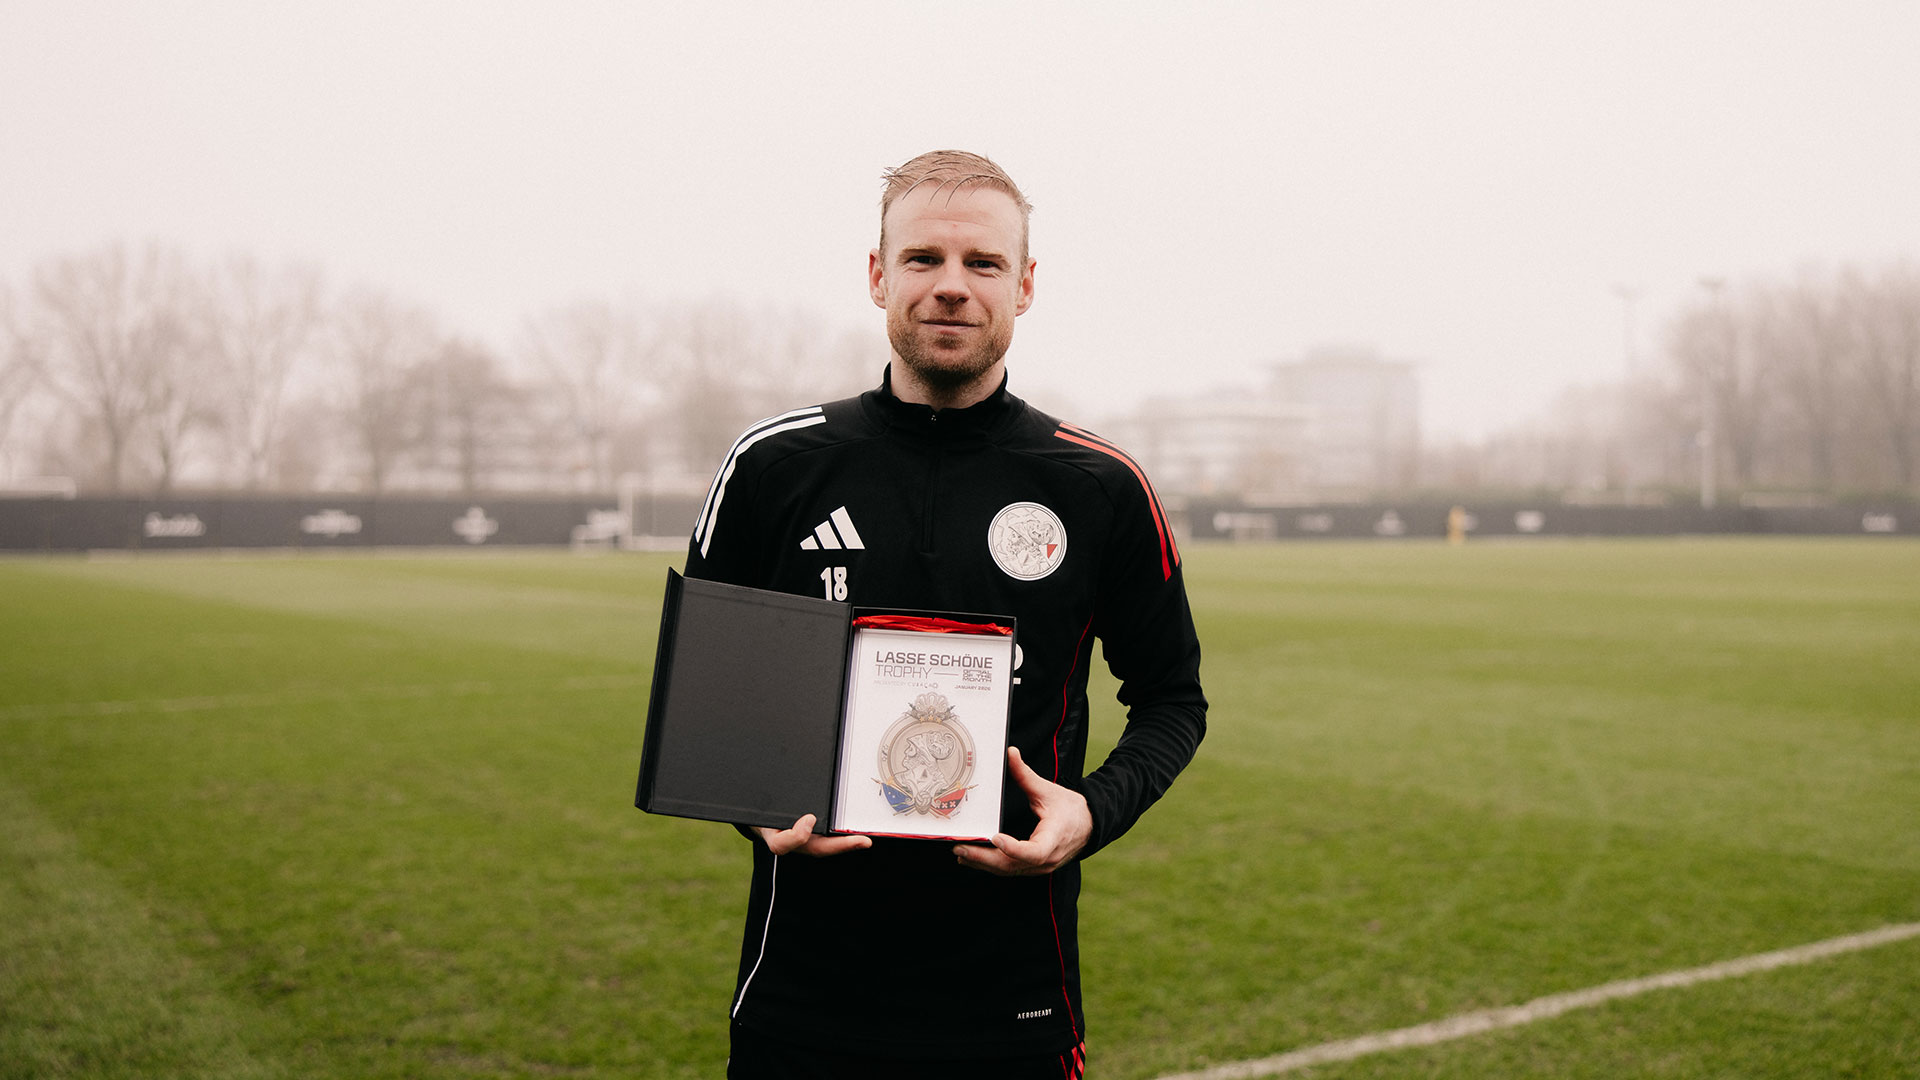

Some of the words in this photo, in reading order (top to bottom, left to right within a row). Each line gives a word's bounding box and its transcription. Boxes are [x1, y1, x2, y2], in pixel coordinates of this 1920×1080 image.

[820, 566, 848, 602] 18
[876, 651, 926, 665] LASSE
[929, 653, 993, 669] SCHÖNE
[875, 664, 933, 679] TROPHY
[1017, 1008, 1052, 1020] AEROREADY
